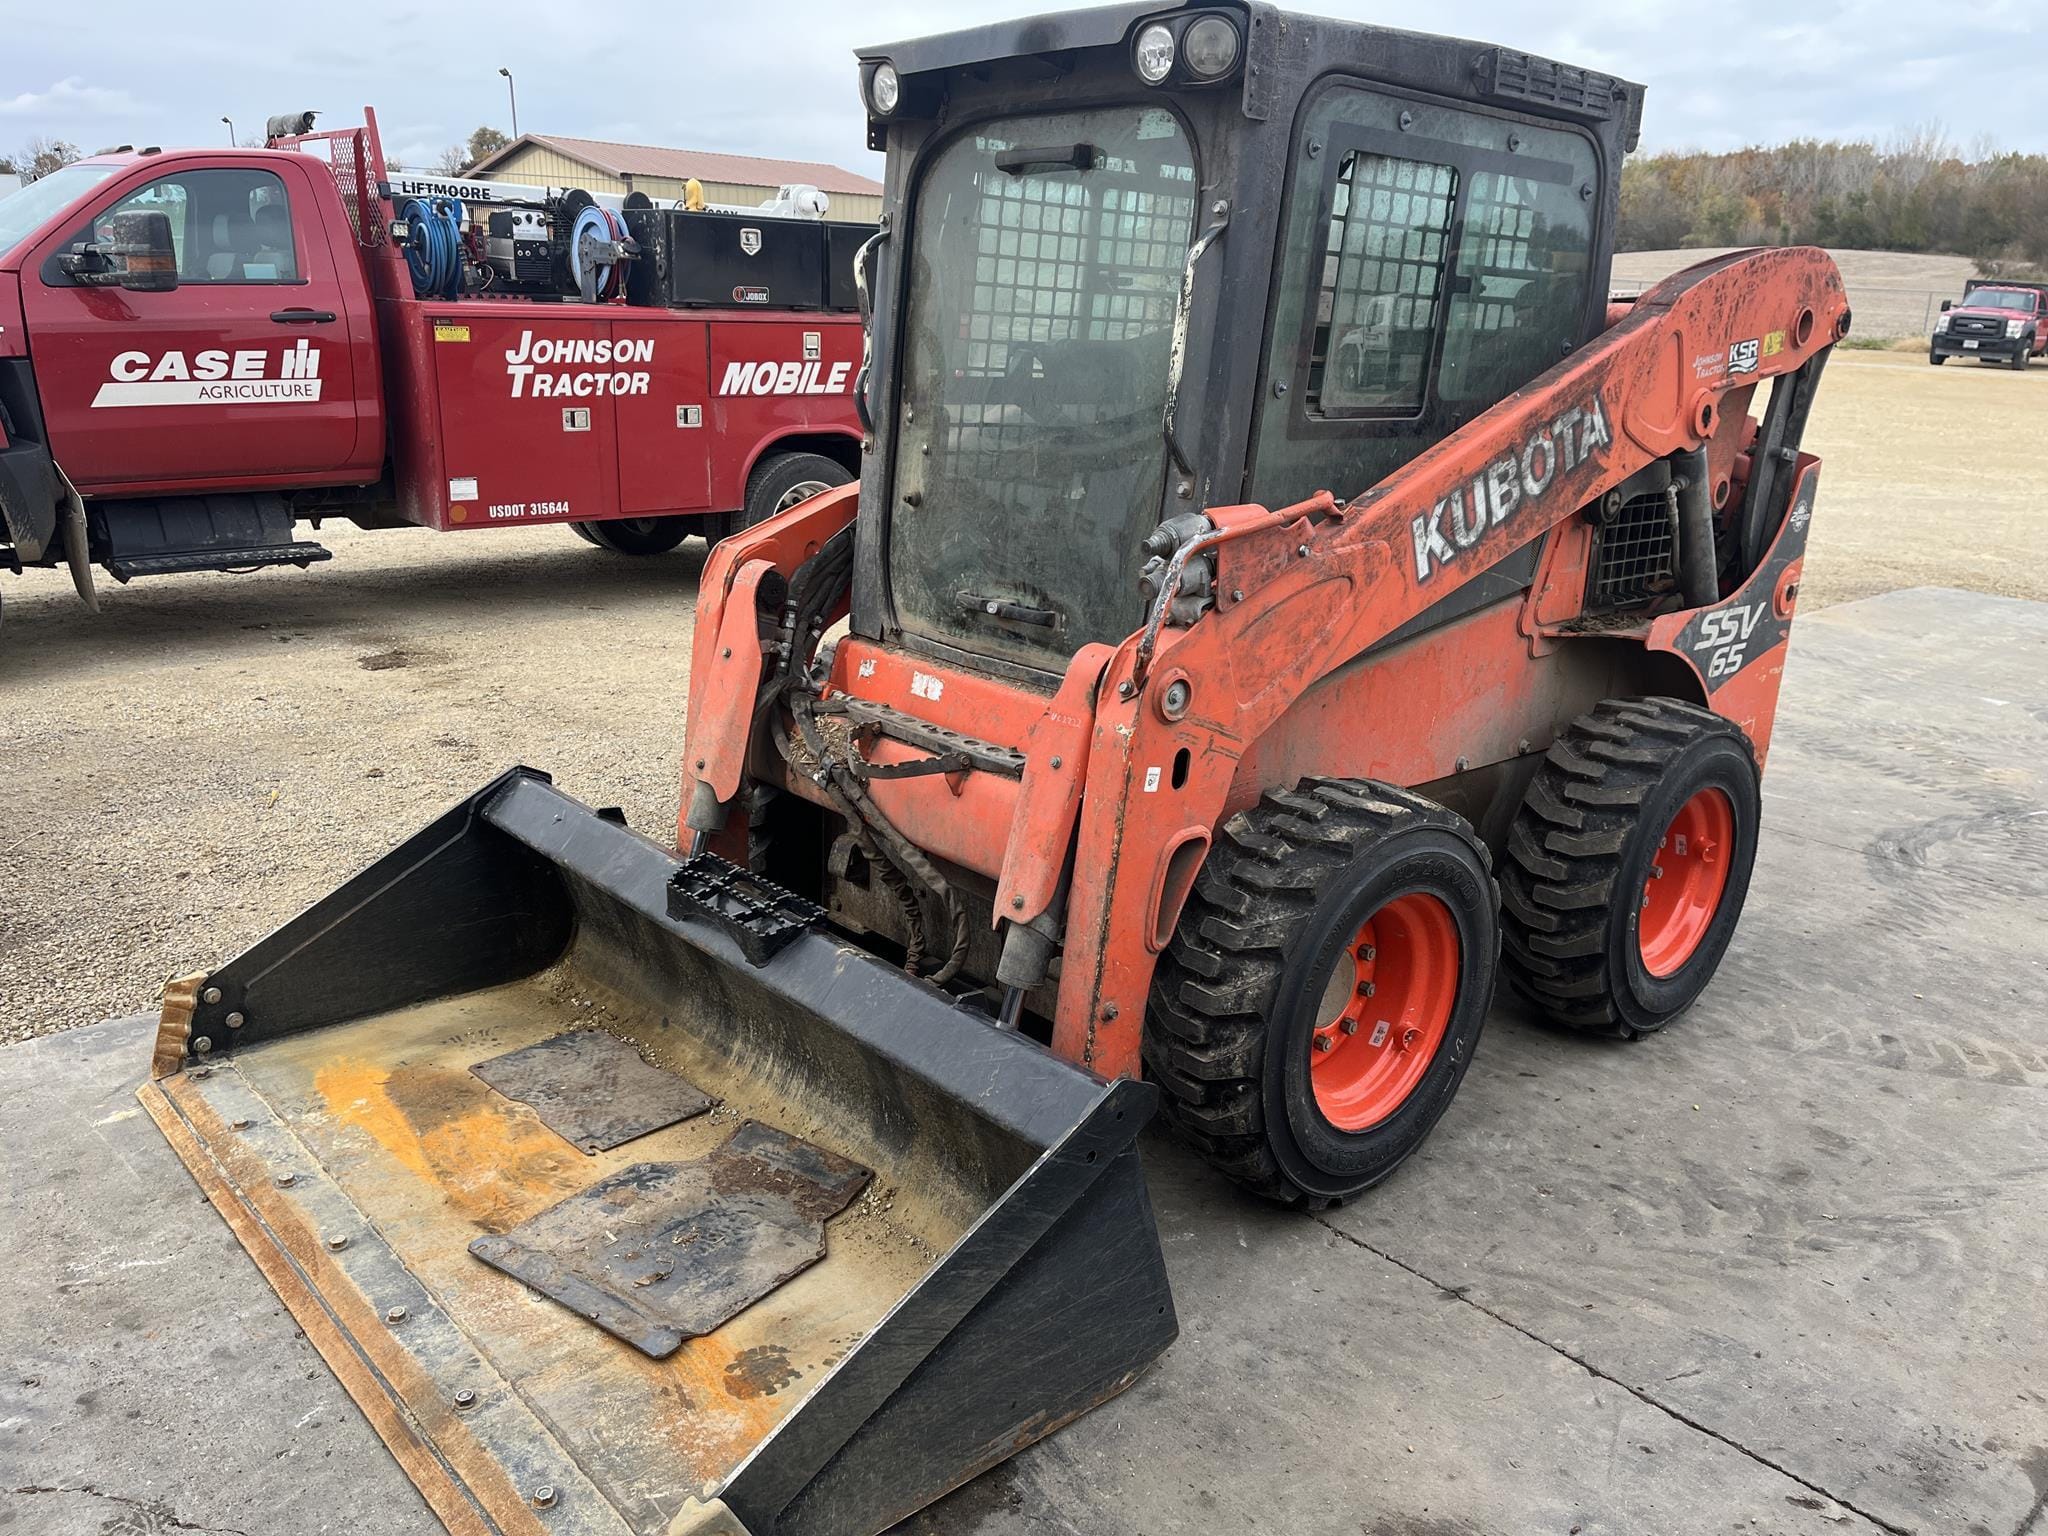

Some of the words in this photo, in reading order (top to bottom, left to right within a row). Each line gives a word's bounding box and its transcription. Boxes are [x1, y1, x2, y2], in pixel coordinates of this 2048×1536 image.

[402, 181, 491, 200] LIFTMOORE
[746, 292, 767, 301] JOBOX
[505, 330, 655, 364] JOHNSON
[1729, 340, 1759, 362] KSR
[110, 350, 268, 382] CASE
[507, 364, 650, 398] TRACTOR
[719, 361, 852, 396] MOBILE
[199, 384, 313, 399] AGRICULTURE
[1412, 395, 1609, 582] KUBOTA
[489, 504, 526, 518] USDOT
[530, 501, 569, 515] 315644
[1694, 602, 1767, 651] SSV
[1708, 643, 1748, 678] 65
